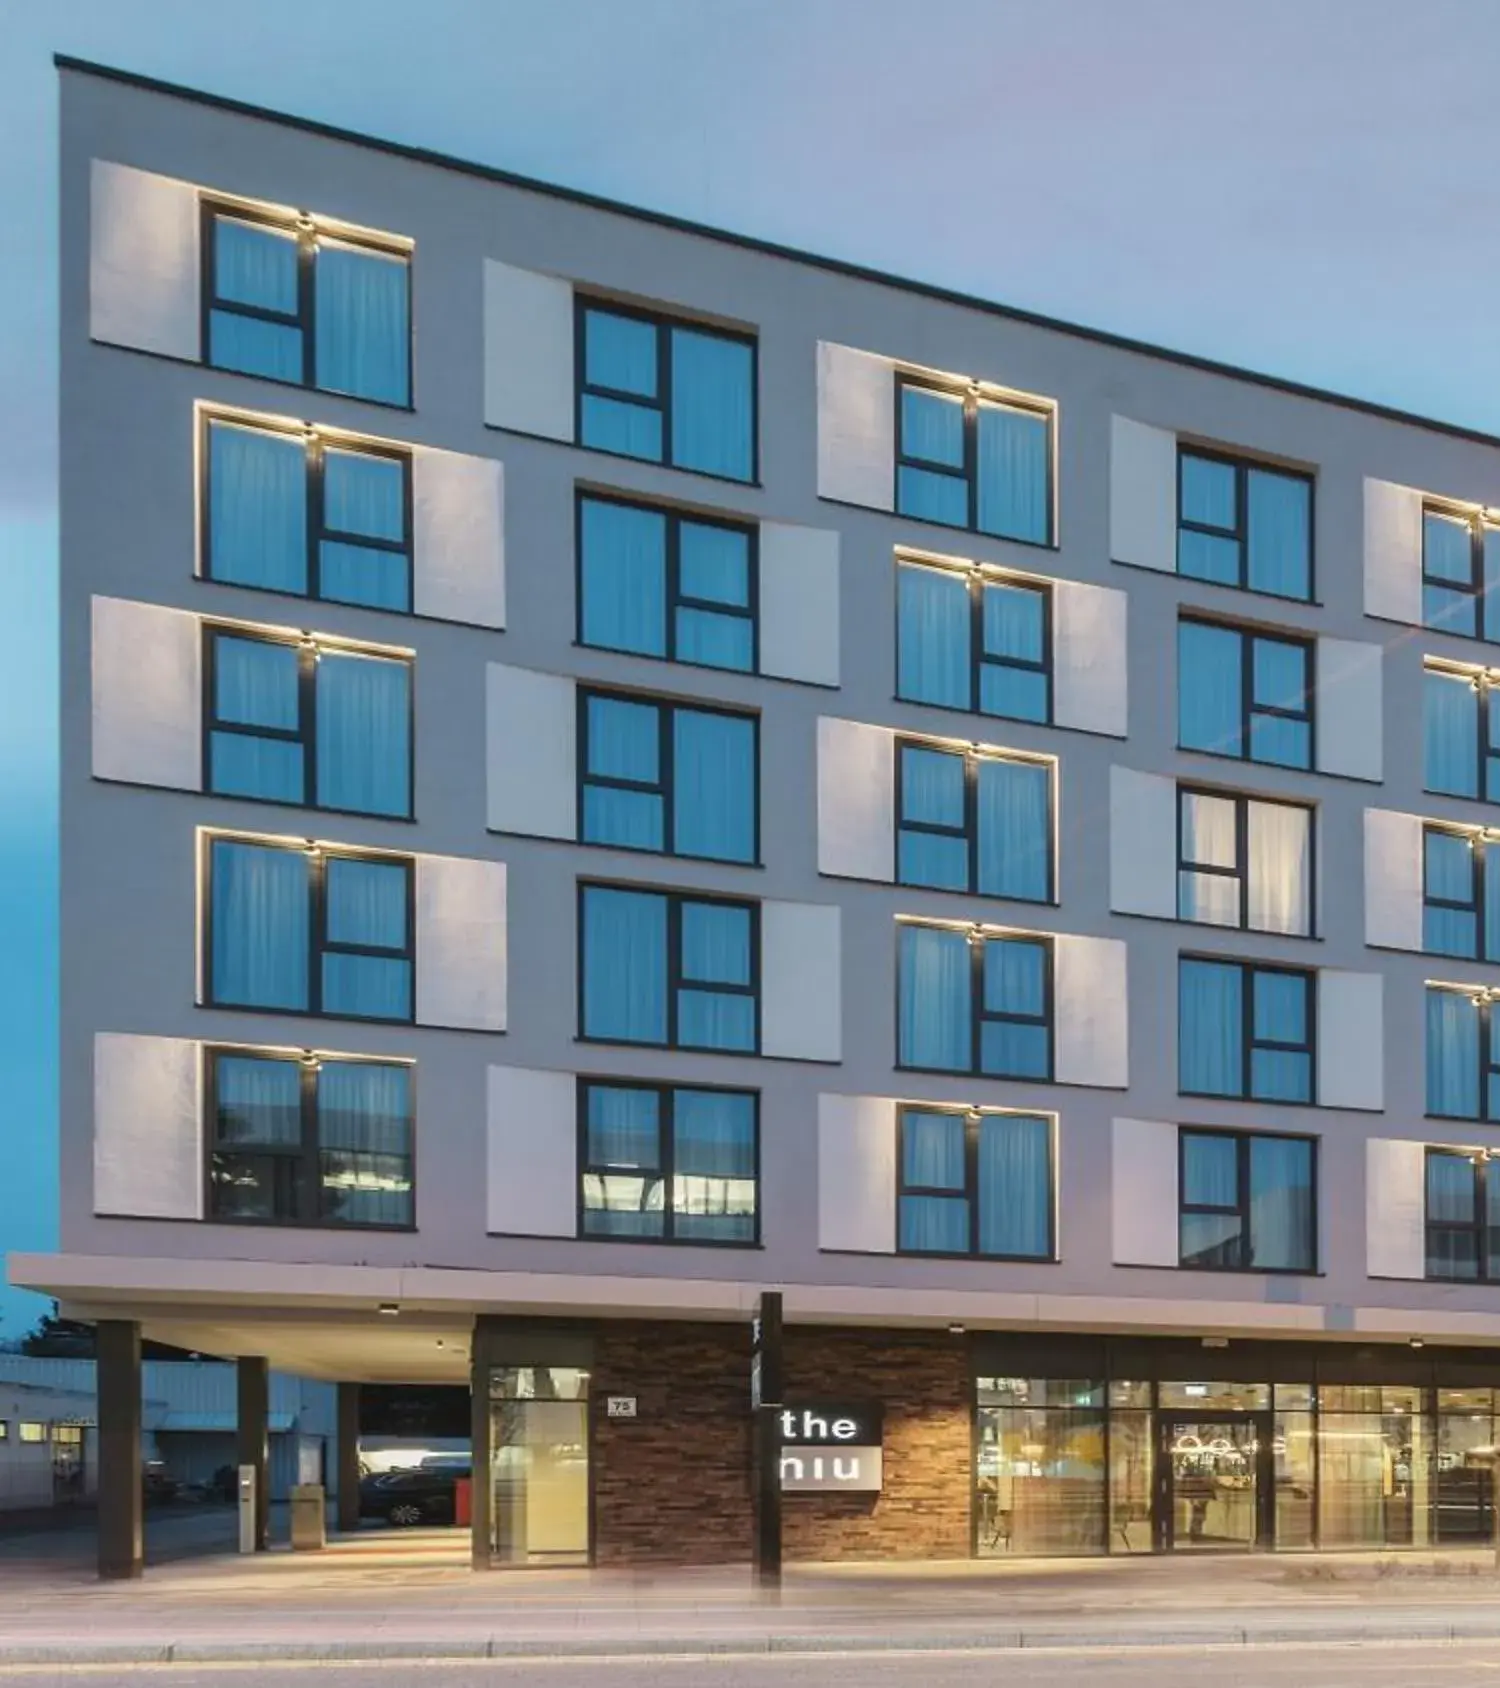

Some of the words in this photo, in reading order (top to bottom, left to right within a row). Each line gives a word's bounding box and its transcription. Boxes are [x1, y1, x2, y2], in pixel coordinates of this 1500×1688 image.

[613, 1401, 630, 1410] 75
[780, 1410, 857, 1438] the
[780, 1457, 859, 1480] niu
